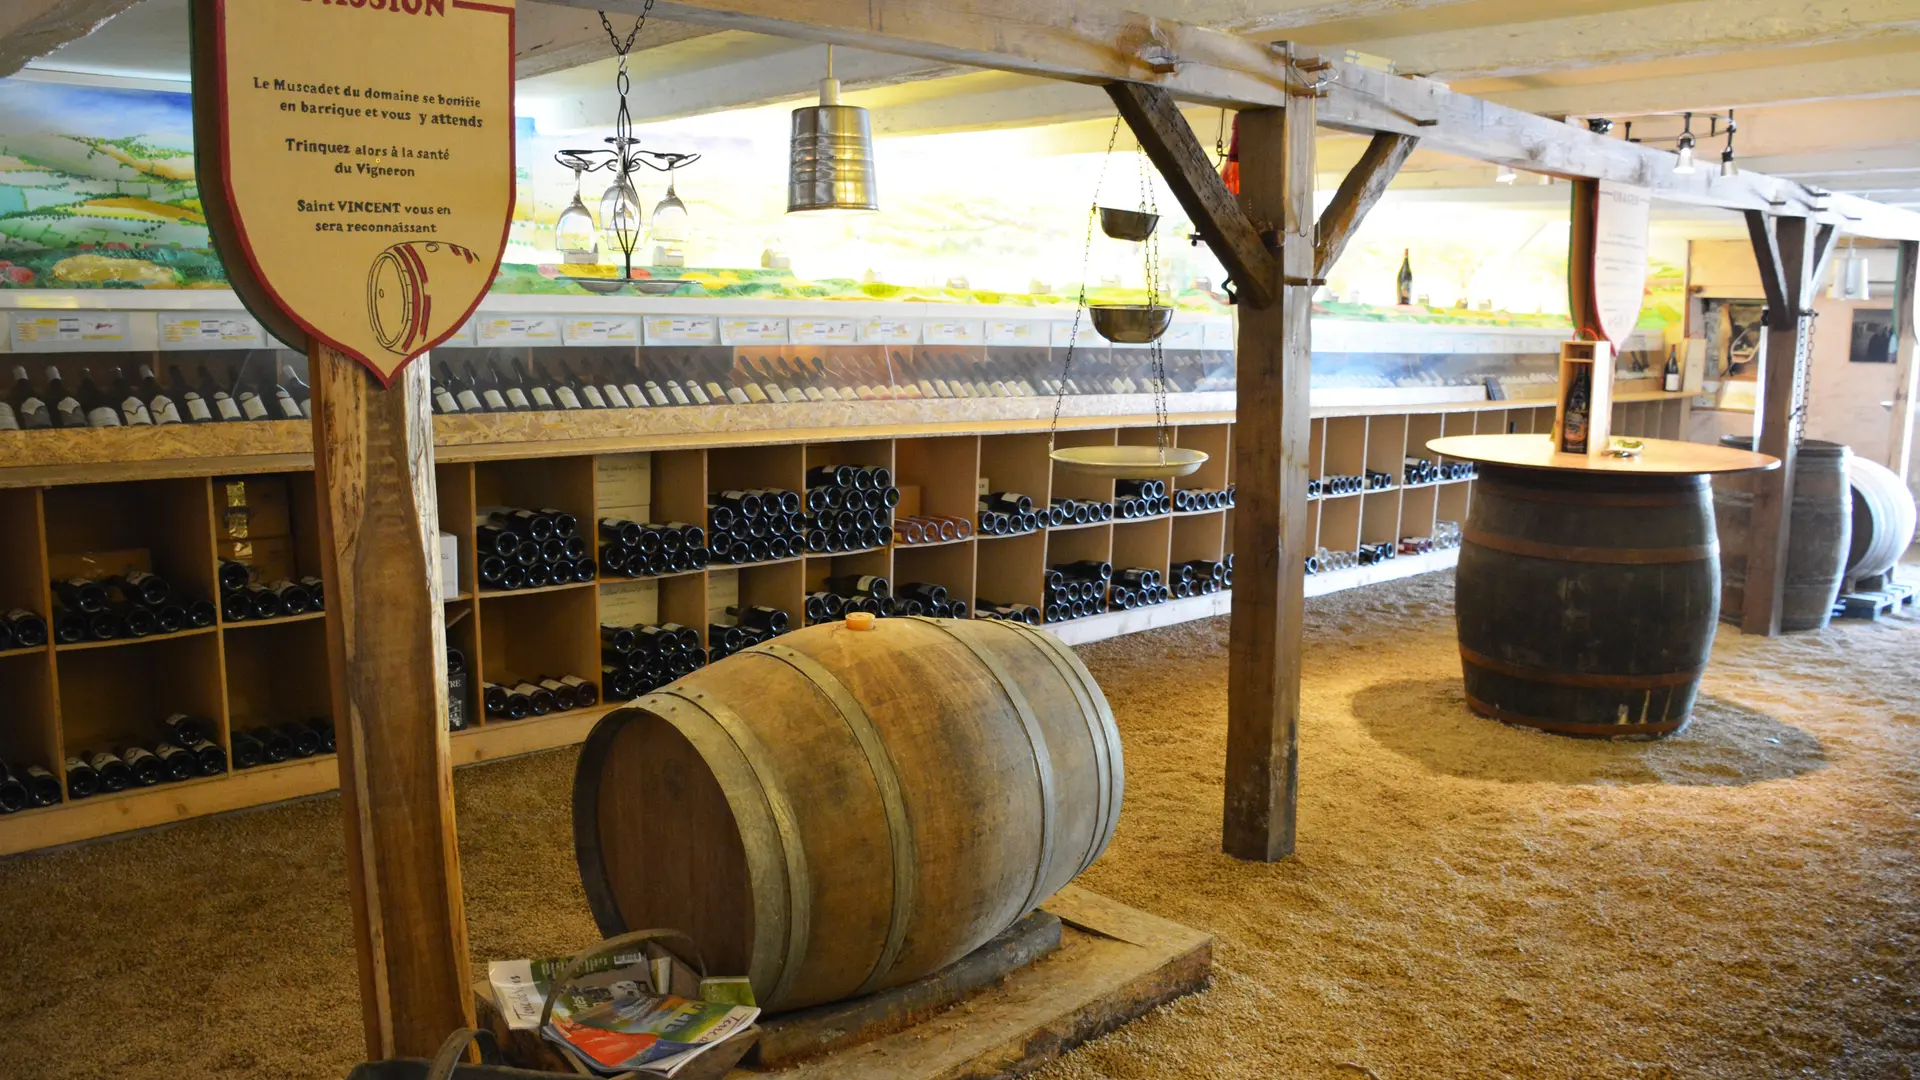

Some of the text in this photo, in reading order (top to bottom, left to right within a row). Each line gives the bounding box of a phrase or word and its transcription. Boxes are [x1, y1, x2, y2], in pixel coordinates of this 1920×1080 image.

[254, 77, 480, 107] Le Muscadet du domaine se bonifie
[280, 101, 483, 127] en barrique et vous y attends
[285, 138, 449, 160] Trinquez alors à la santé
[335, 162, 414, 178] du Vigneron
[297, 199, 335, 212] Saint
[338, 201, 401, 213] VINCENT
[405, 206, 433, 214] vous
[316, 222, 437, 233] sera reconnaissant
